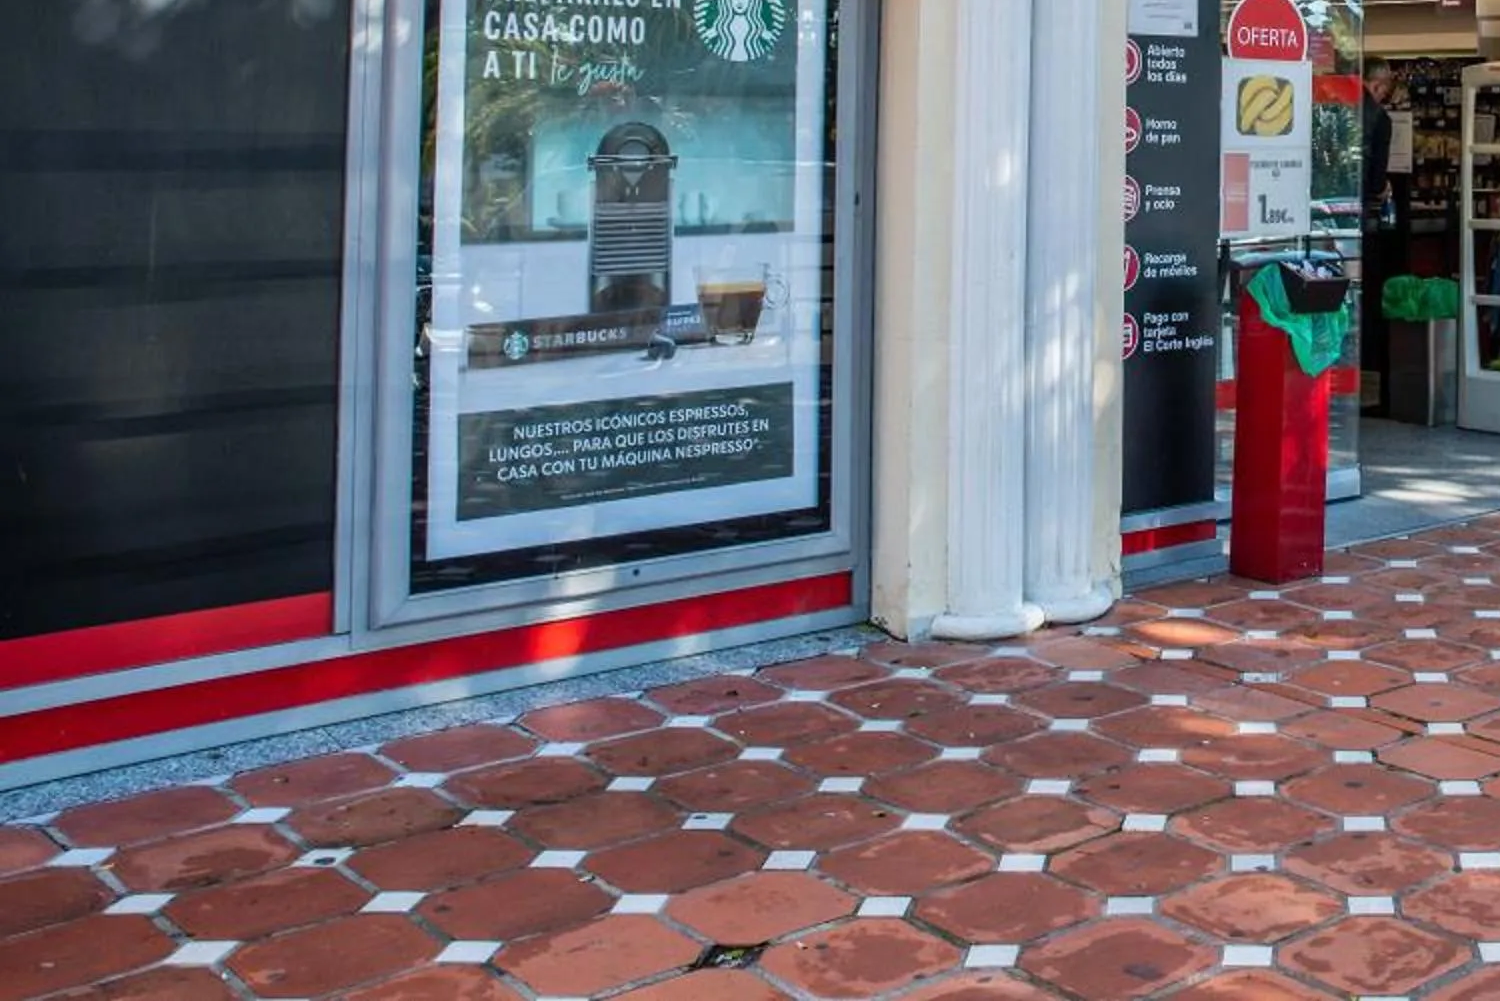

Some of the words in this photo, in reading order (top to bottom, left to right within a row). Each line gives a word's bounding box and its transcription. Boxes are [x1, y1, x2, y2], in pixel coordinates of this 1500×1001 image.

[483, 11, 558, 41] CASA
[568, 14, 646, 44] COMO
[1236, 26, 1299, 47] OFERTA
[1147, 44, 1185, 59] Abierto
[483, 50, 500, 79] A
[512, 50, 537, 80] TI
[1147, 58, 1177, 70] todos
[1147, 70, 1165, 83] los
[1145, 132, 1158, 144] de
[1161, 133, 1181, 146] pan
[1153, 198, 1176, 211] ocio
[1144, 253, 1187, 268] Recarga
[1143, 266, 1158, 278] de
[1143, 312, 1169, 327] Pago
[1171, 311, 1189, 323] con
[532, 326, 628, 351] STARBUCKS
[513, 419, 593, 440] NUESTROS
[595, 410, 667, 432] ICÓNICOS
[573, 433, 612, 453] PARA
[615, 430, 645, 448] QUE
[648, 428, 675, 444] LOS
[678, 420, 749, 441] DISFRUTES
[753, 418, 769, 433] EN
[497, 465, 538, 482] CASA
[541, 459, 575, 476] CON
[580, 456, 598, 471] TU
[600, 448, 671, 470] MÁQUINA
